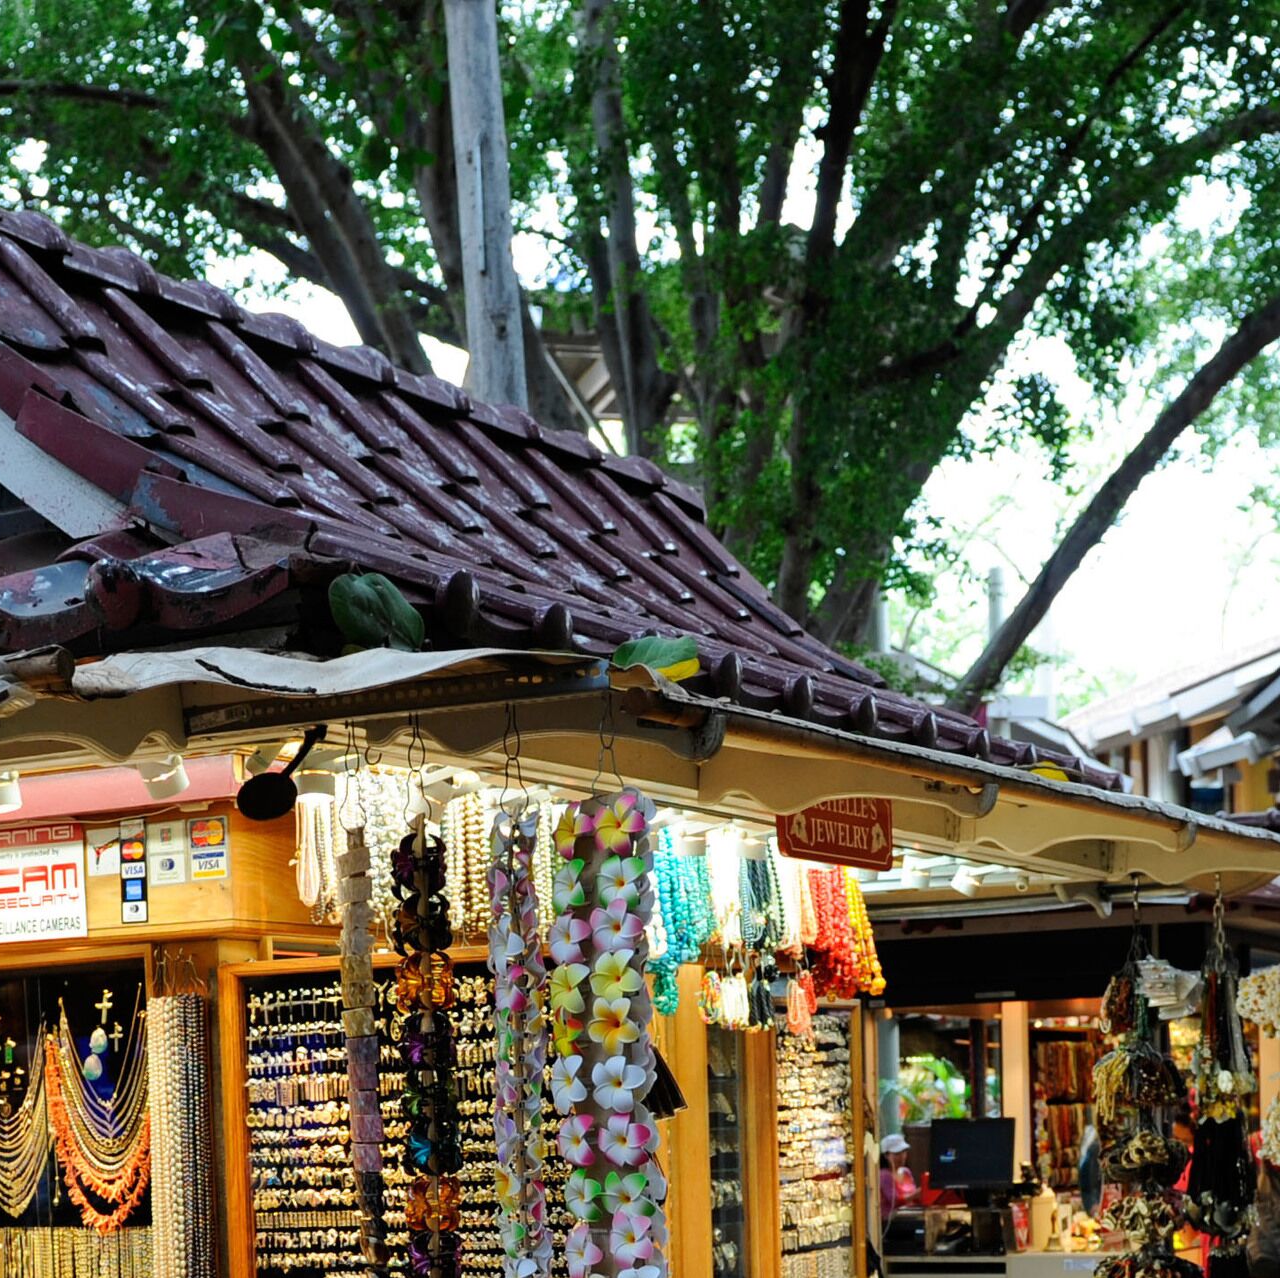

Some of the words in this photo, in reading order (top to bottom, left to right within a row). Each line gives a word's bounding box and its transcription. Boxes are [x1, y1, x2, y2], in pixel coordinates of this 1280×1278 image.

[810, 818, 870, 849] JEWELRY
[20, 848, 49, 858] protected
[51, 847, 60, 857] by
[125, 864, 143, 876] VISA
[198, 859, 220, 870] VISA
[40, 916, 80, 933] CAMERAS
